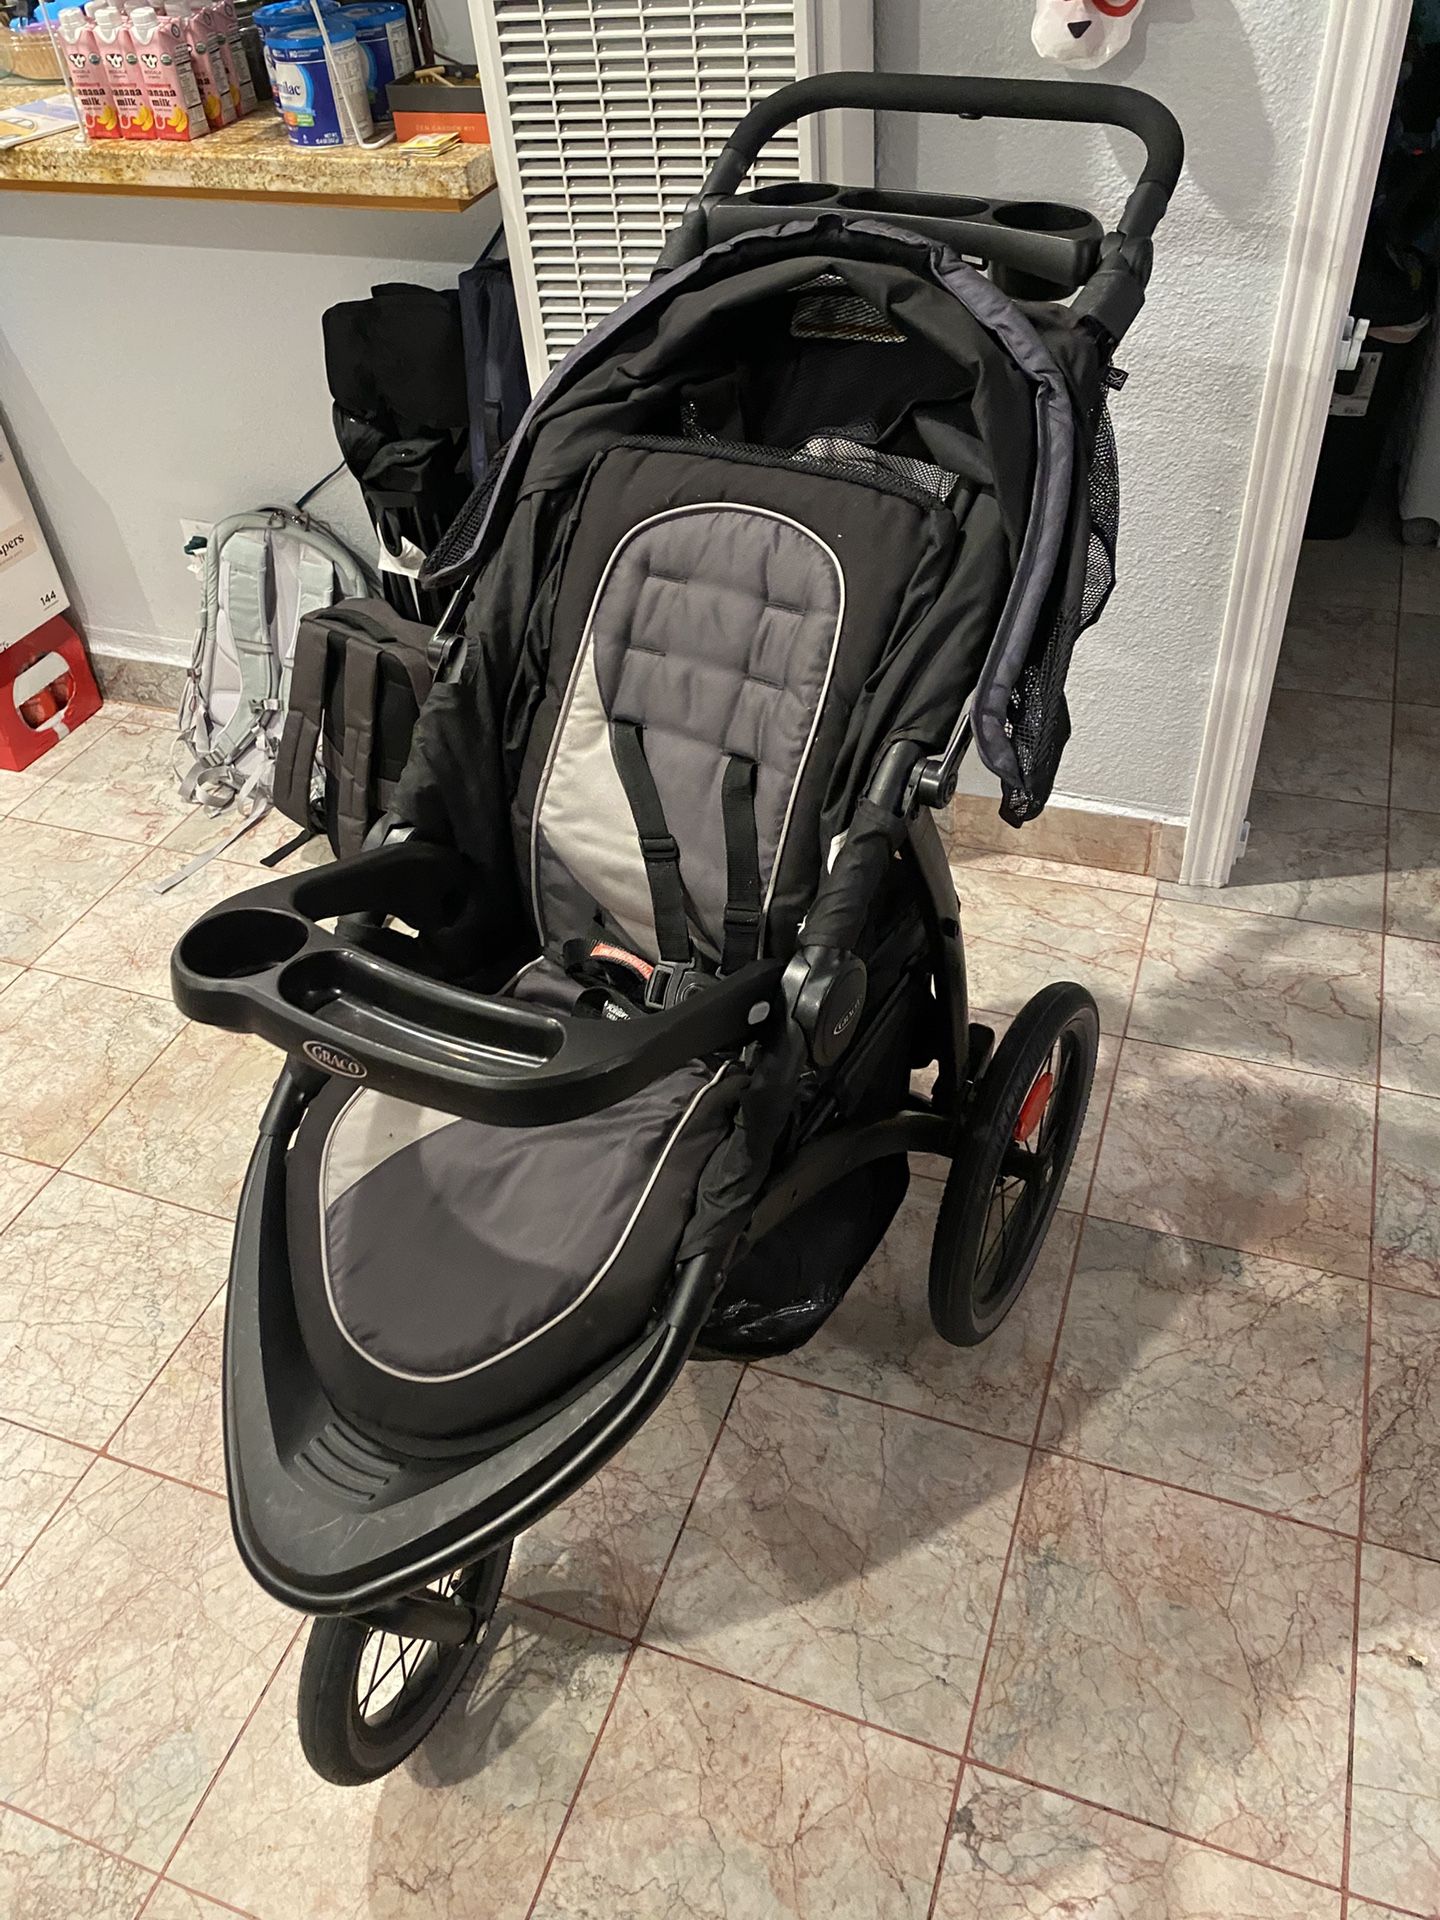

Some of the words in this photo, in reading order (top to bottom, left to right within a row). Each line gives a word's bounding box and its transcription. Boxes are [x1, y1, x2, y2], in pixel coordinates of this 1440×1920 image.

[81, 97, 101, 106] milk
[116, 98, 137, 106] milk
[151, 98, 171, 107] milk
[0, 534, 25, 557] pers
[40, 590, 57, 606] 144
[311, 1045, 360, 1075] GRACO
